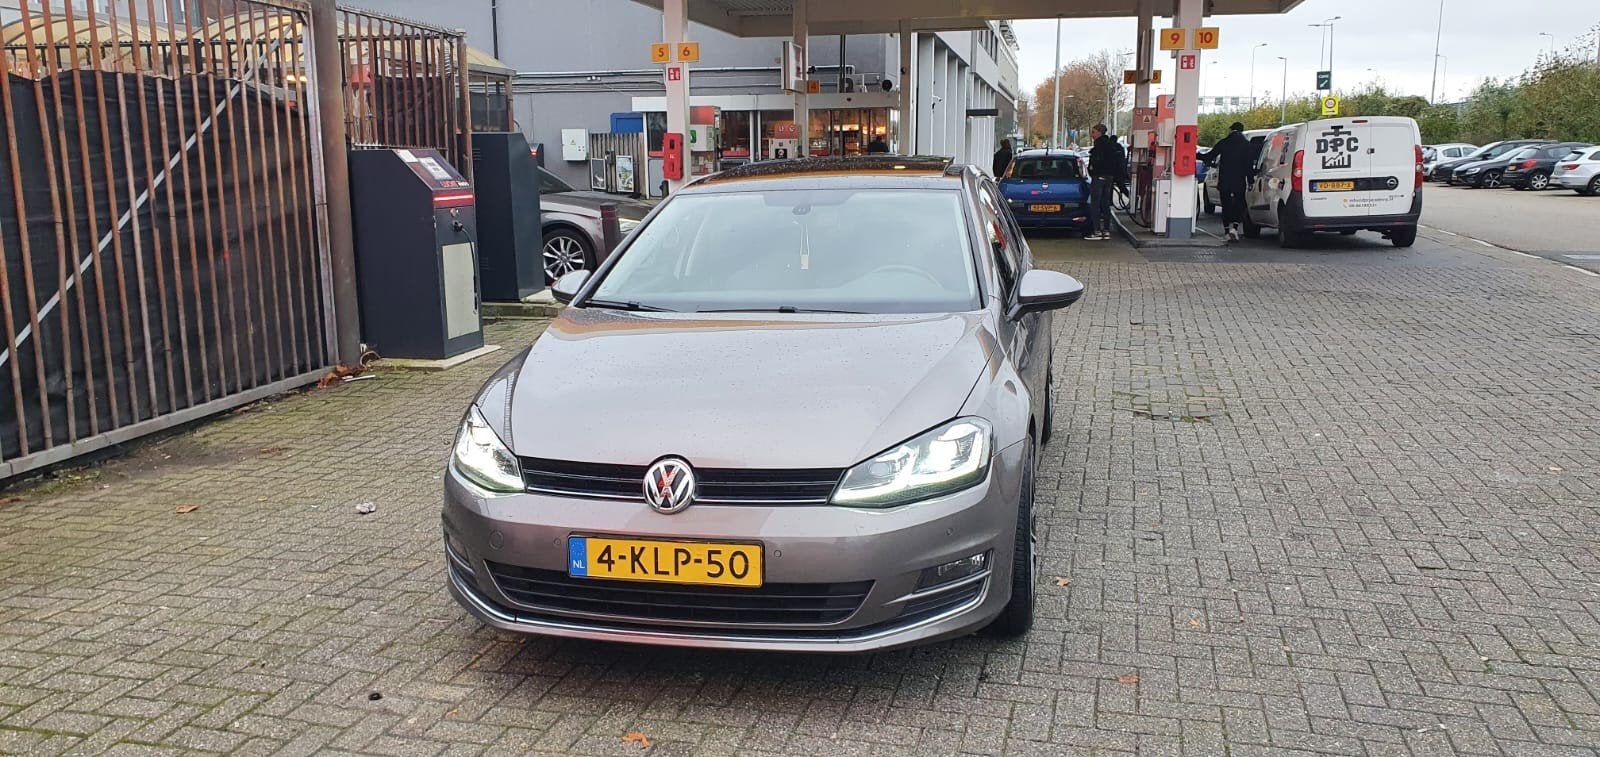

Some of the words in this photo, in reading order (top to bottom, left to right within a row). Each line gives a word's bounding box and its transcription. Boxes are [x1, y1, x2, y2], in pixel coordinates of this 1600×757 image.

[1170, 33, 1180, 44] 9
[1199, 32, 1213, 44] 10
[658, 47, 664, 57] 5
[682, 47, 690, 56] 6
[1316, 137, 1359, 153] DPC
[573, 560, 585, 569] NL
[597, 544, 749, 579] 4-KLP-50
